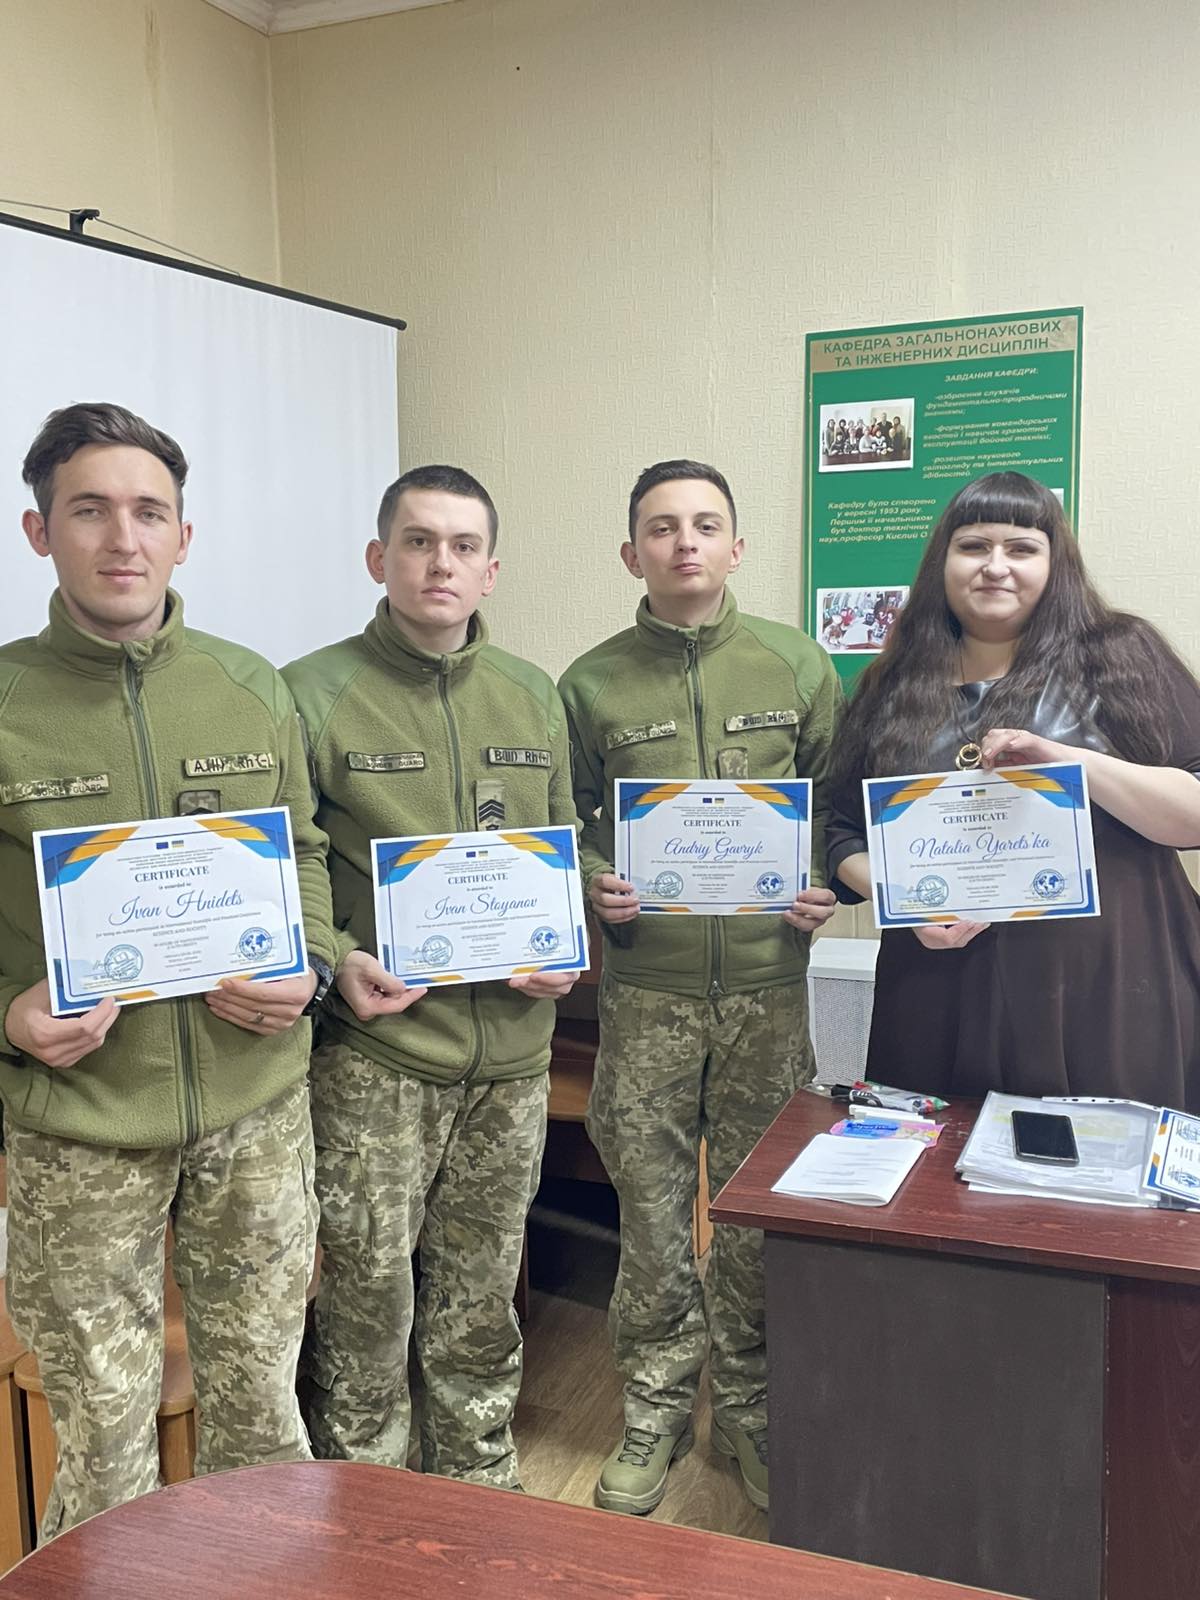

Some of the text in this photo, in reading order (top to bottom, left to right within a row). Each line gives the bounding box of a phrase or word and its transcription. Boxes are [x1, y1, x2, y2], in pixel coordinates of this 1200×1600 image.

[823, 320, 1061, 353] КАФЕДРА ЗАГАЛЬНОНАУКОВИХ
[835, 337, 1048, 367] ТА ІНЖЕНЕРНИХ ДИСЦИПЛІН
[944, 372, 993, 382] ЗАВДАННЯ
[828, 501, 866, 510] Кафедру
[848, 526, 881, 534] доктор
[943, 812, 1008, 824] CERTIFICATE
[664, 837, 763, 861] Andriy Gavryk
[910, 838, 972, 858] Natalia
[135, 866, 210, 883] CERTIFICATE
[448, 872, 508, 885] CERTIFICATE
[109, 889, 243, 926] Ivan Hnidets
[425, 893, 537, 920] Ivan Stoyanov
